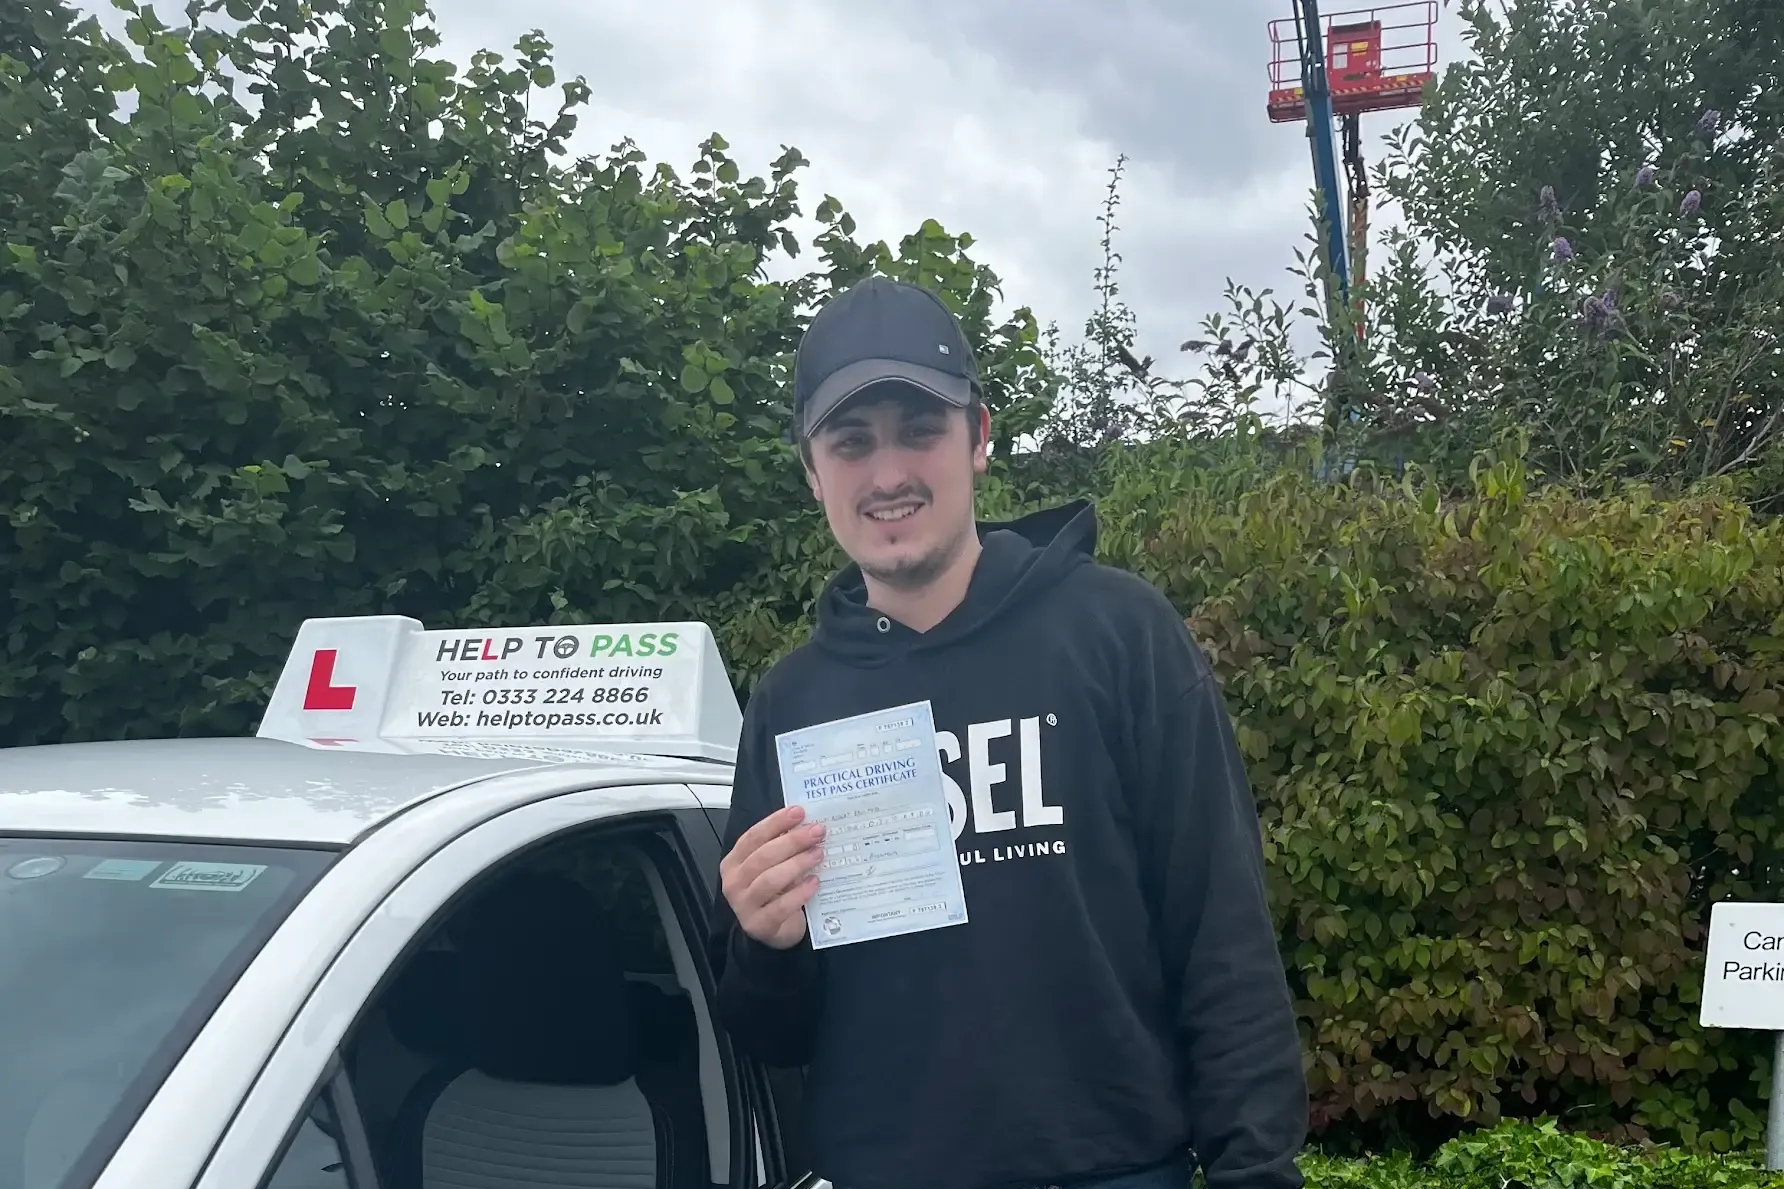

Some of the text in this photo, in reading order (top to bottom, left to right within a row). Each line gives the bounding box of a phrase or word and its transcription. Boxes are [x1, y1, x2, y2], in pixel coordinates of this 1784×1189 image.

[436, 632, 680, 662] HELP TO PASS
[302, 649, 357, 711] L
[440, 665, 663, 683] Your path to confident driving
[441, 686, 649, 707] Tel: 0333 224 8866
[416, 708, 664, 730] Web: helptopass.co.uk
[803, 757, 917, 790] PRACTICAL DRIVING
[805, 768, 918, 800] TEST PASS CERTIFICATE
[993, 840, 1066, 862] LIVING
